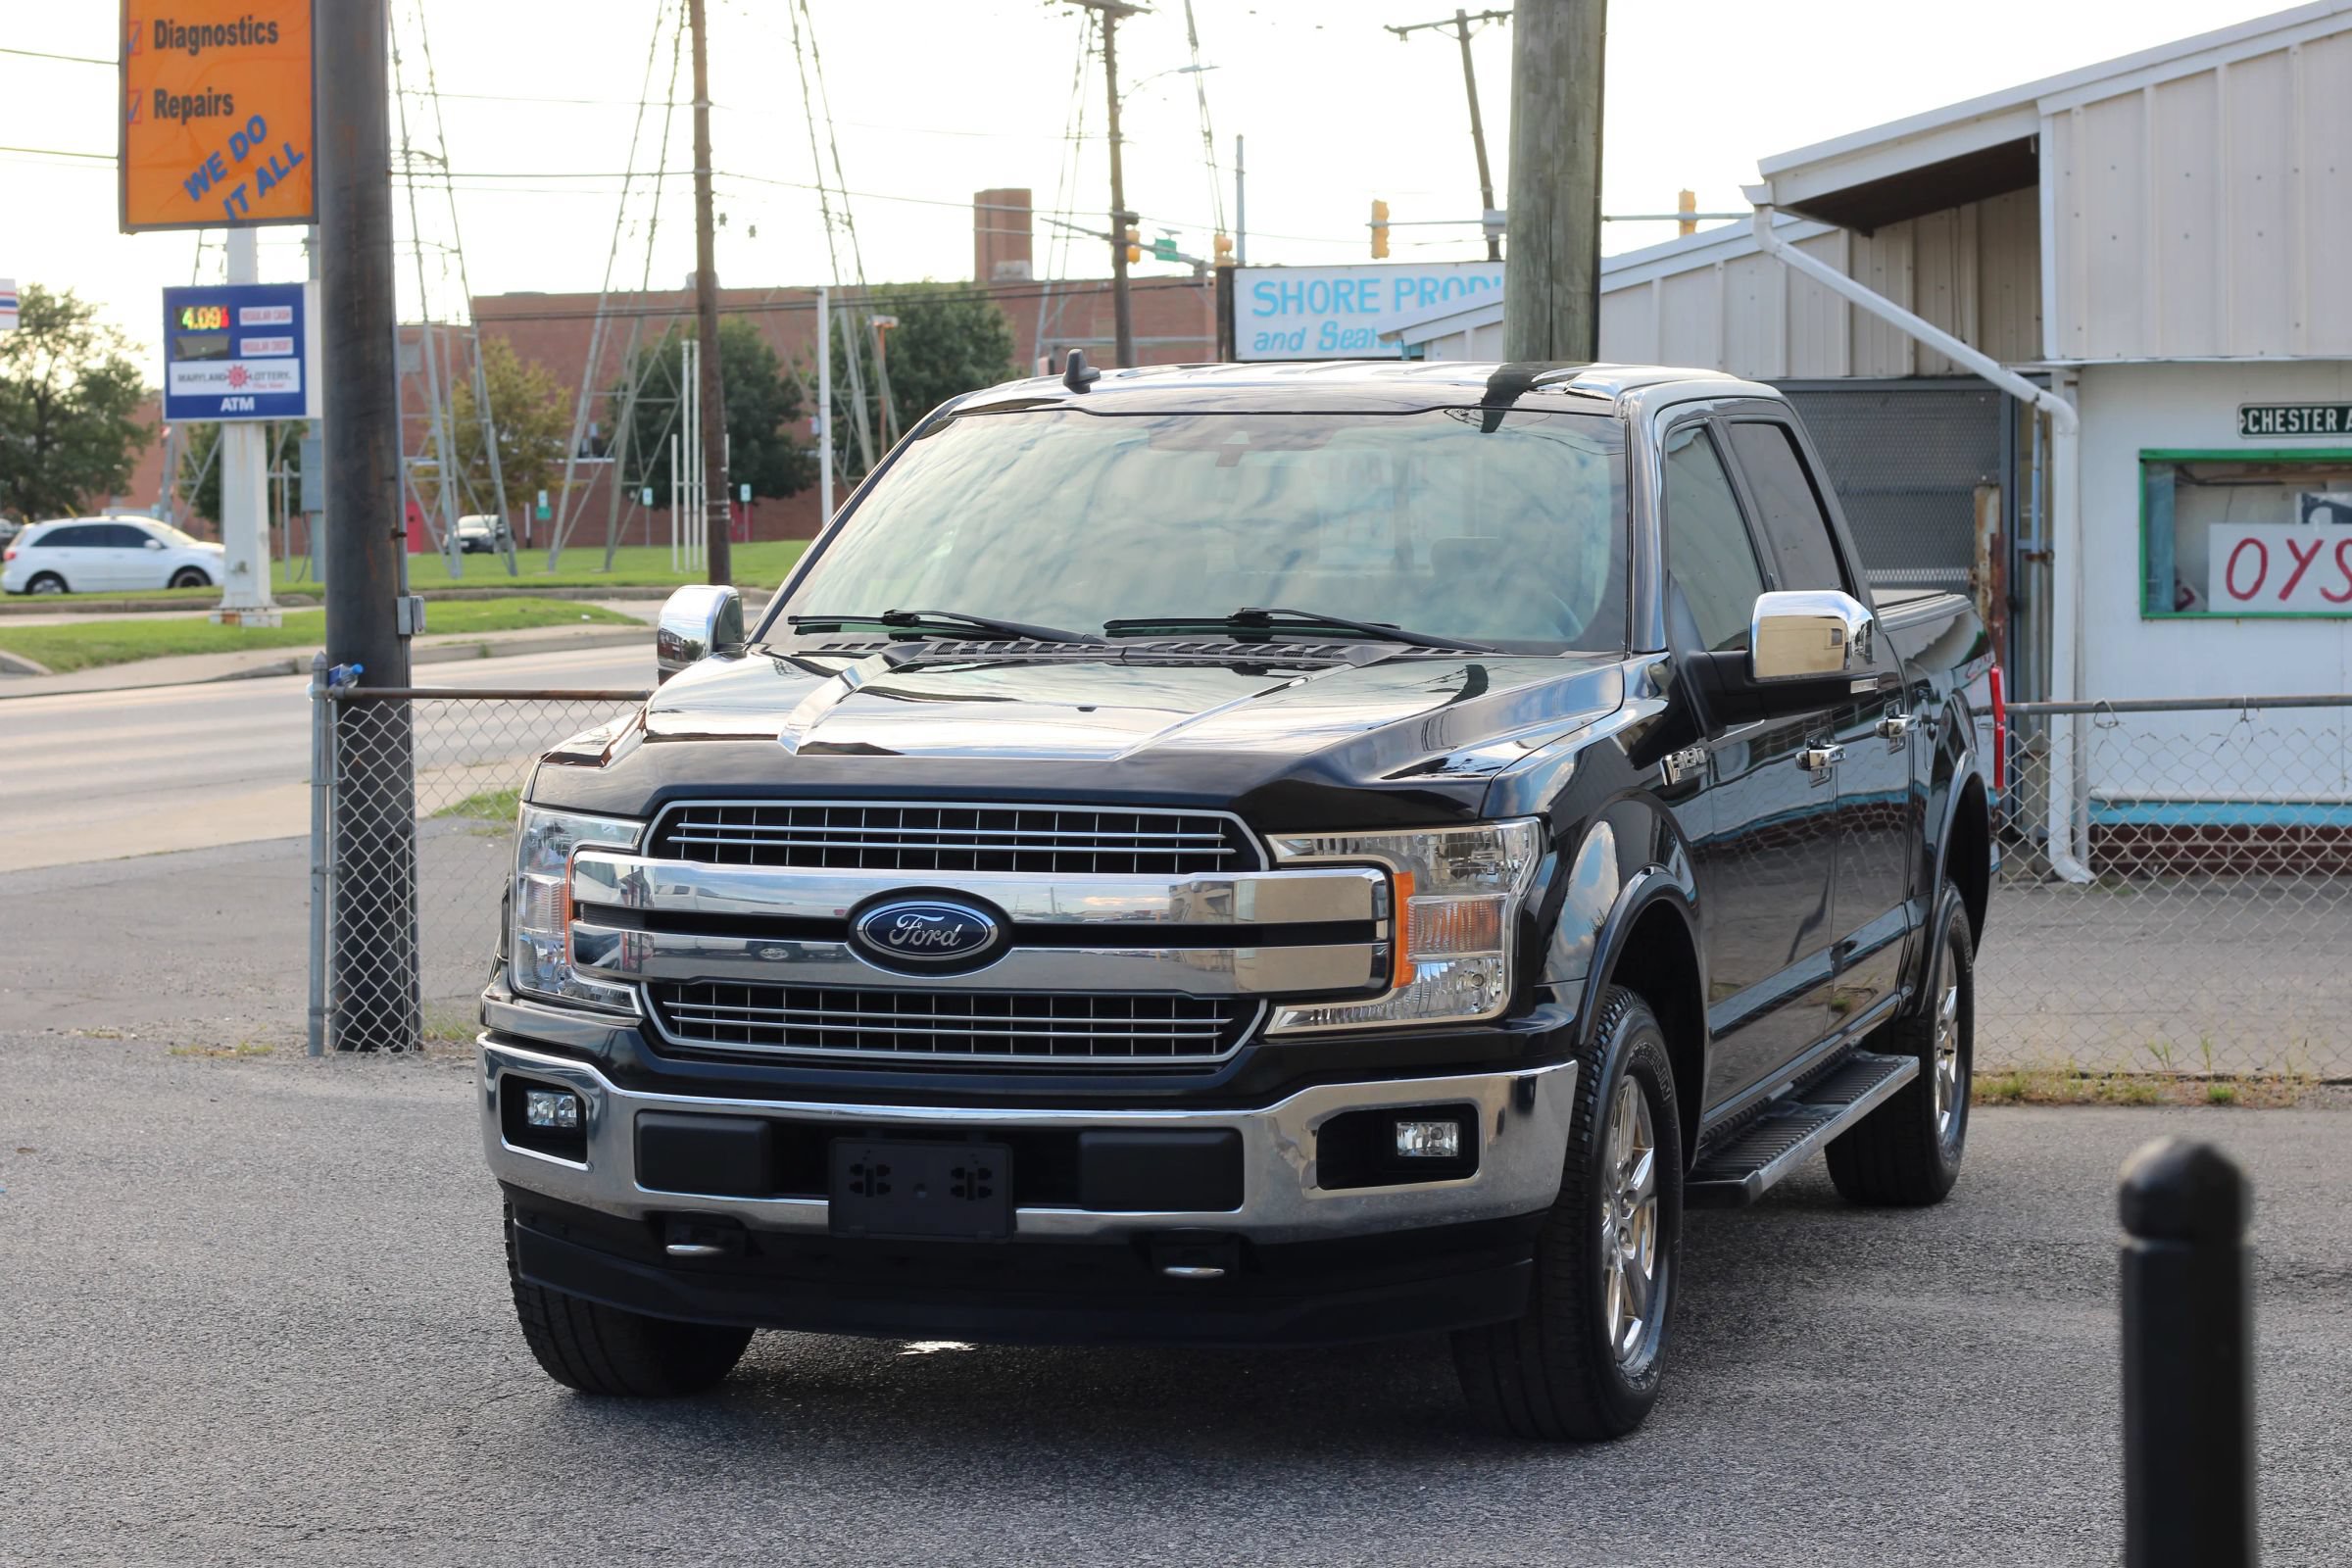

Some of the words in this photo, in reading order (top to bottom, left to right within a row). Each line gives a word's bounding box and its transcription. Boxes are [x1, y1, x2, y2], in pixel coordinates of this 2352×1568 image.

[154, 15, 278, 56] Diagnostics
[154, 86, 234, 125] Repairs
[183, 151, 227, 202] WE
[228, 114, 267, 163] DO
[222, 182, 250, 220] IT
[256, 141, 305, 199] ALL
[1252, 279, 1381, 318] SHORE
[1394, 275, 1502, 312] PROD
[1252, 326, 1307, 352] and
[177, 372, 227, 383] MARYLAND
[220, 397, 255, 413] ATM
[2247, 408, 2338, 433] CHESTER
[889, 913, 963, 947] Ford
